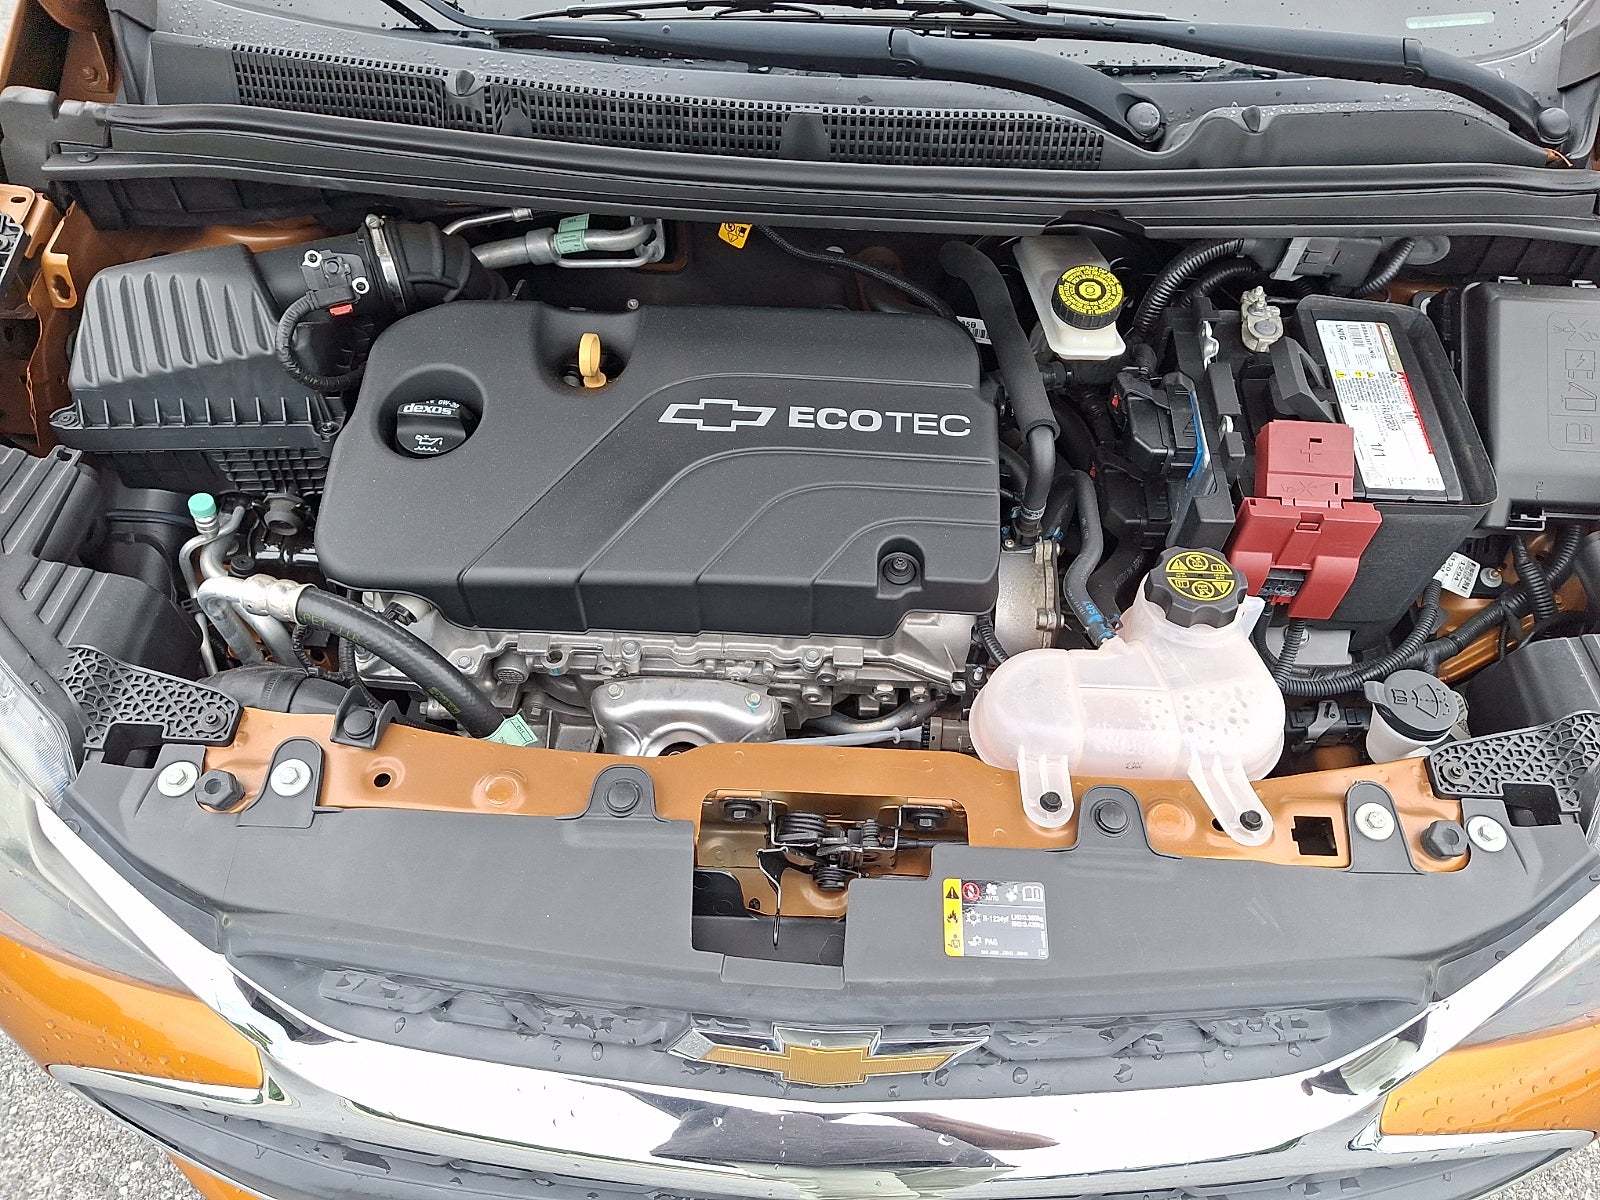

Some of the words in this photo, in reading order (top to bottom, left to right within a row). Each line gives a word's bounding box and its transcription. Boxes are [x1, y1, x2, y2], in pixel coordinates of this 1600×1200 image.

[1335, 324, 1347, 341] LN1G
[788, 406, 971, 437] ECOTEC
[1370, 442, 1387, 457] 1/1
[984, 937, 998, 946] PAG
